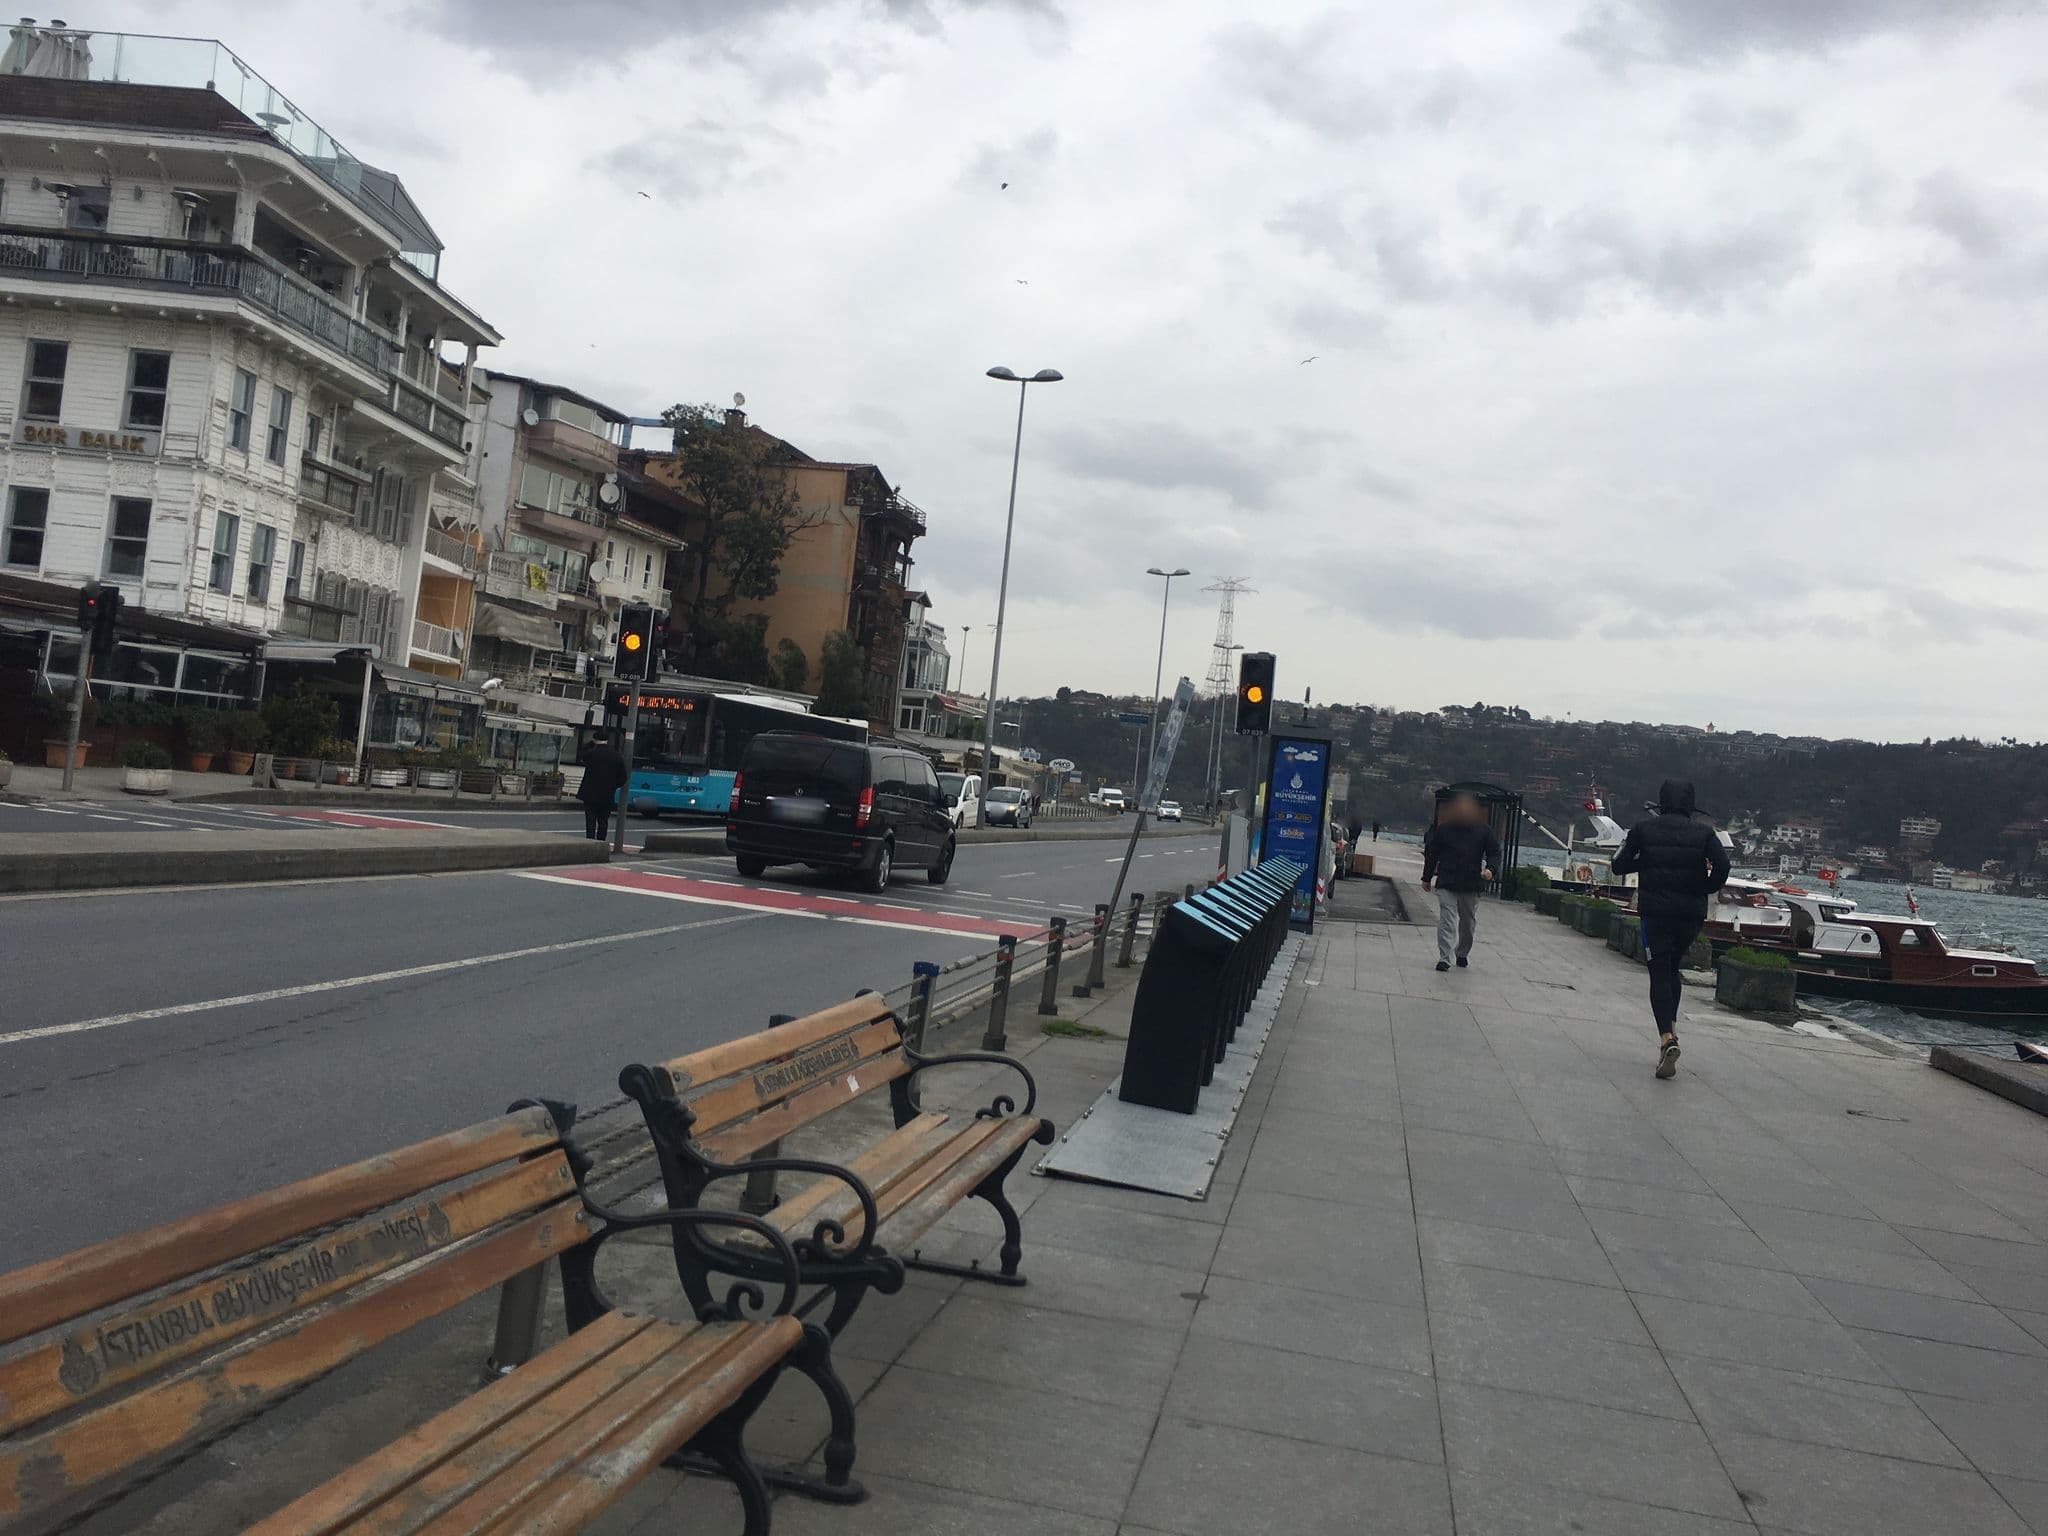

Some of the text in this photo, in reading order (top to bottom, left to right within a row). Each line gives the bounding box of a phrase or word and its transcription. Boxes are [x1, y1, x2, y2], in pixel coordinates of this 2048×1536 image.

[79, 430, 145, 453] BALIK
[97, 1298, 214, 1367] İSTANBUL
[212, 1247, 337, 1324] BÜYÜKŞEHİR
